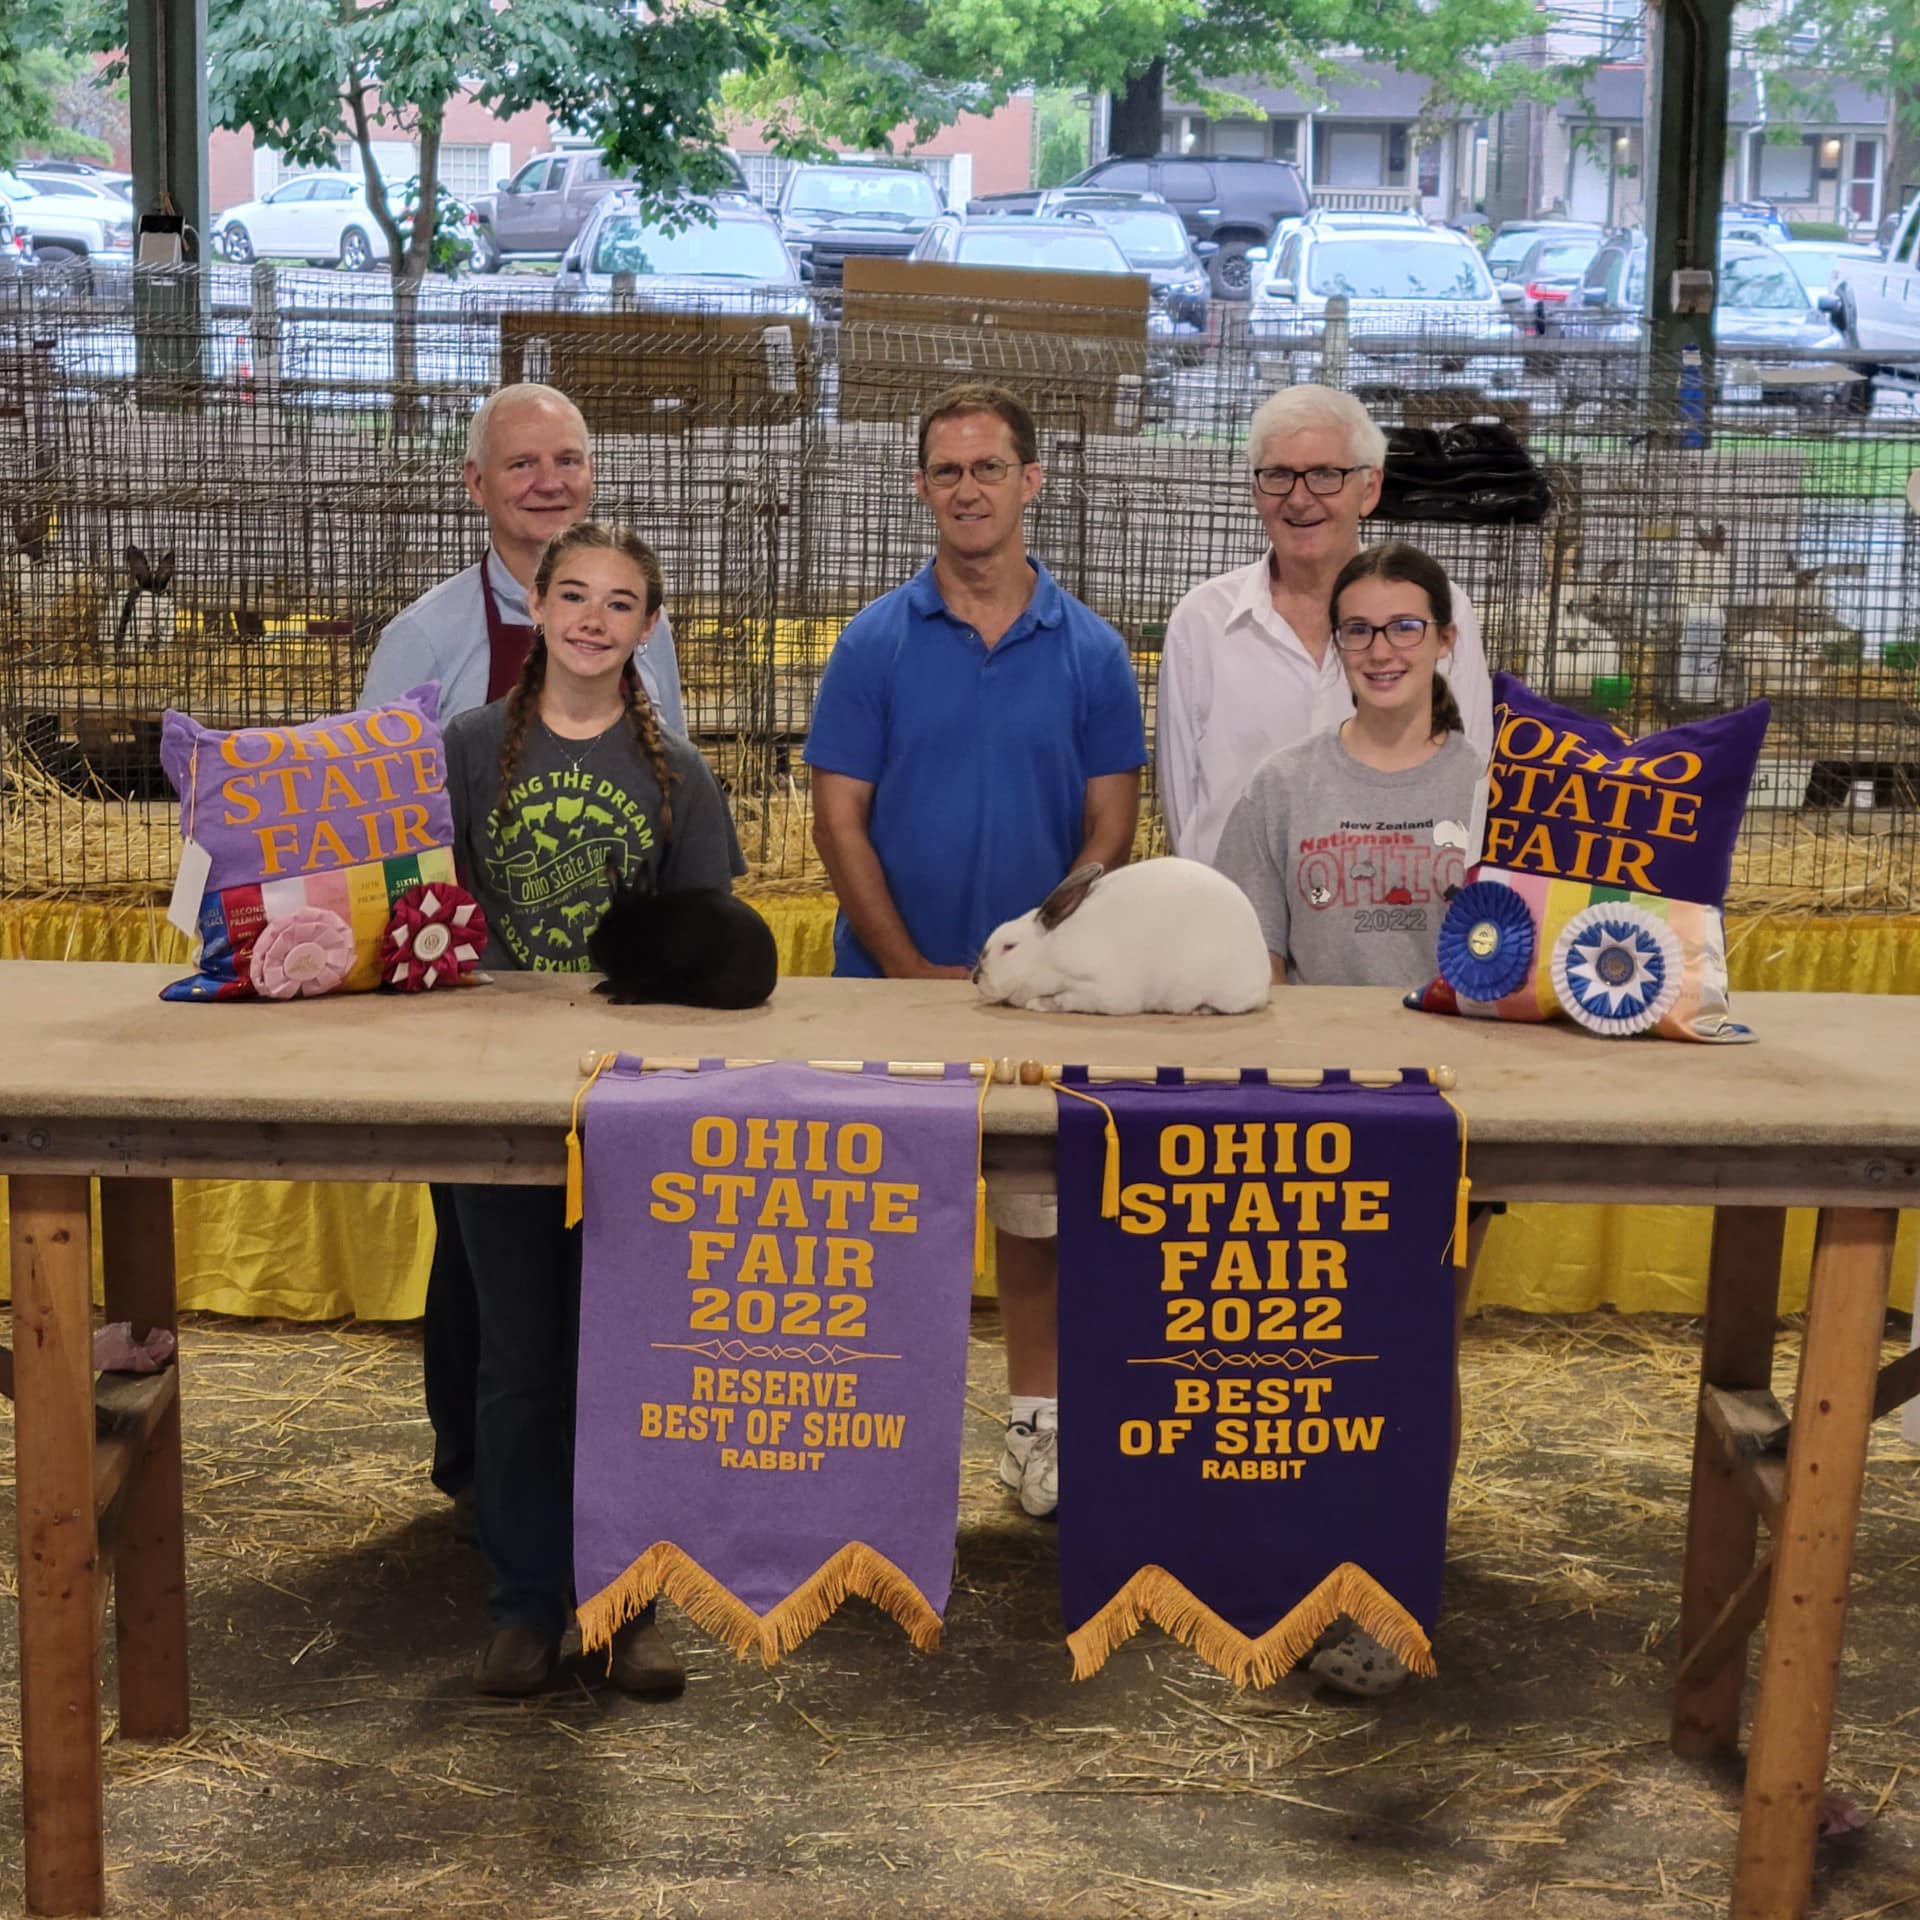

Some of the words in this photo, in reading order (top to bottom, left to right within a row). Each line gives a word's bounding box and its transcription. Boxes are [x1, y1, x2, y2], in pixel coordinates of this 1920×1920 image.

[220, 710, 423, 768] OHIO
[1500, 716, 1702, 784] OHIO
[221, 748, 444, 825] STATE
[549, 771, 593, 791] THE
[597, 780, 654, 850] DREAM
[1488, 762, 1702, 843] STATE
[252, 803, 440, 875] FAIR
[1299, 832, 1415, 852] Nationals
[1340, 820, 1371, 830] New
[1376, 819, 1433, 831] Zealand
[521, 874, 549, 900] ohio
[550, 856, 586, 889] state
[1482, 817, 1662, 894] FAIR
[396, 877, 419, 889] SIXTH
[501, 914, 529, 963] 2022
[1355, 908, 1427, 933] 2022
[690, 1116, 883, 1174] OHIO
[1159, 1122, 1352, 1176] OHIO
[650, 1171, 920, 1233] STATE
[1120, 1180, 1390, 1234] STATE
[687, 1230, 875, 1288] FAIR
[1160, 1239, 1348, 1292] FAIR
[690, 1287, 867, 1338] 2022
[1165, 1296, 1343, 1342] 2022
[692, 1366, 858, 1408] RESERVE
[1174, 1377, 1333, 1414] BEST
[639, 1402, 734, 1443] BEST
[746, 1408, 791, 1446] OF
[803, 1412, 906, 1449] SHOW
[1119, 1418, 1192, 1456] OF
[1215, 1416, 1385, 1455] SHOW
[721, 1448, 826, 1472] RABBIT
[1202, 1458, 1307, 1480] RABBIT
